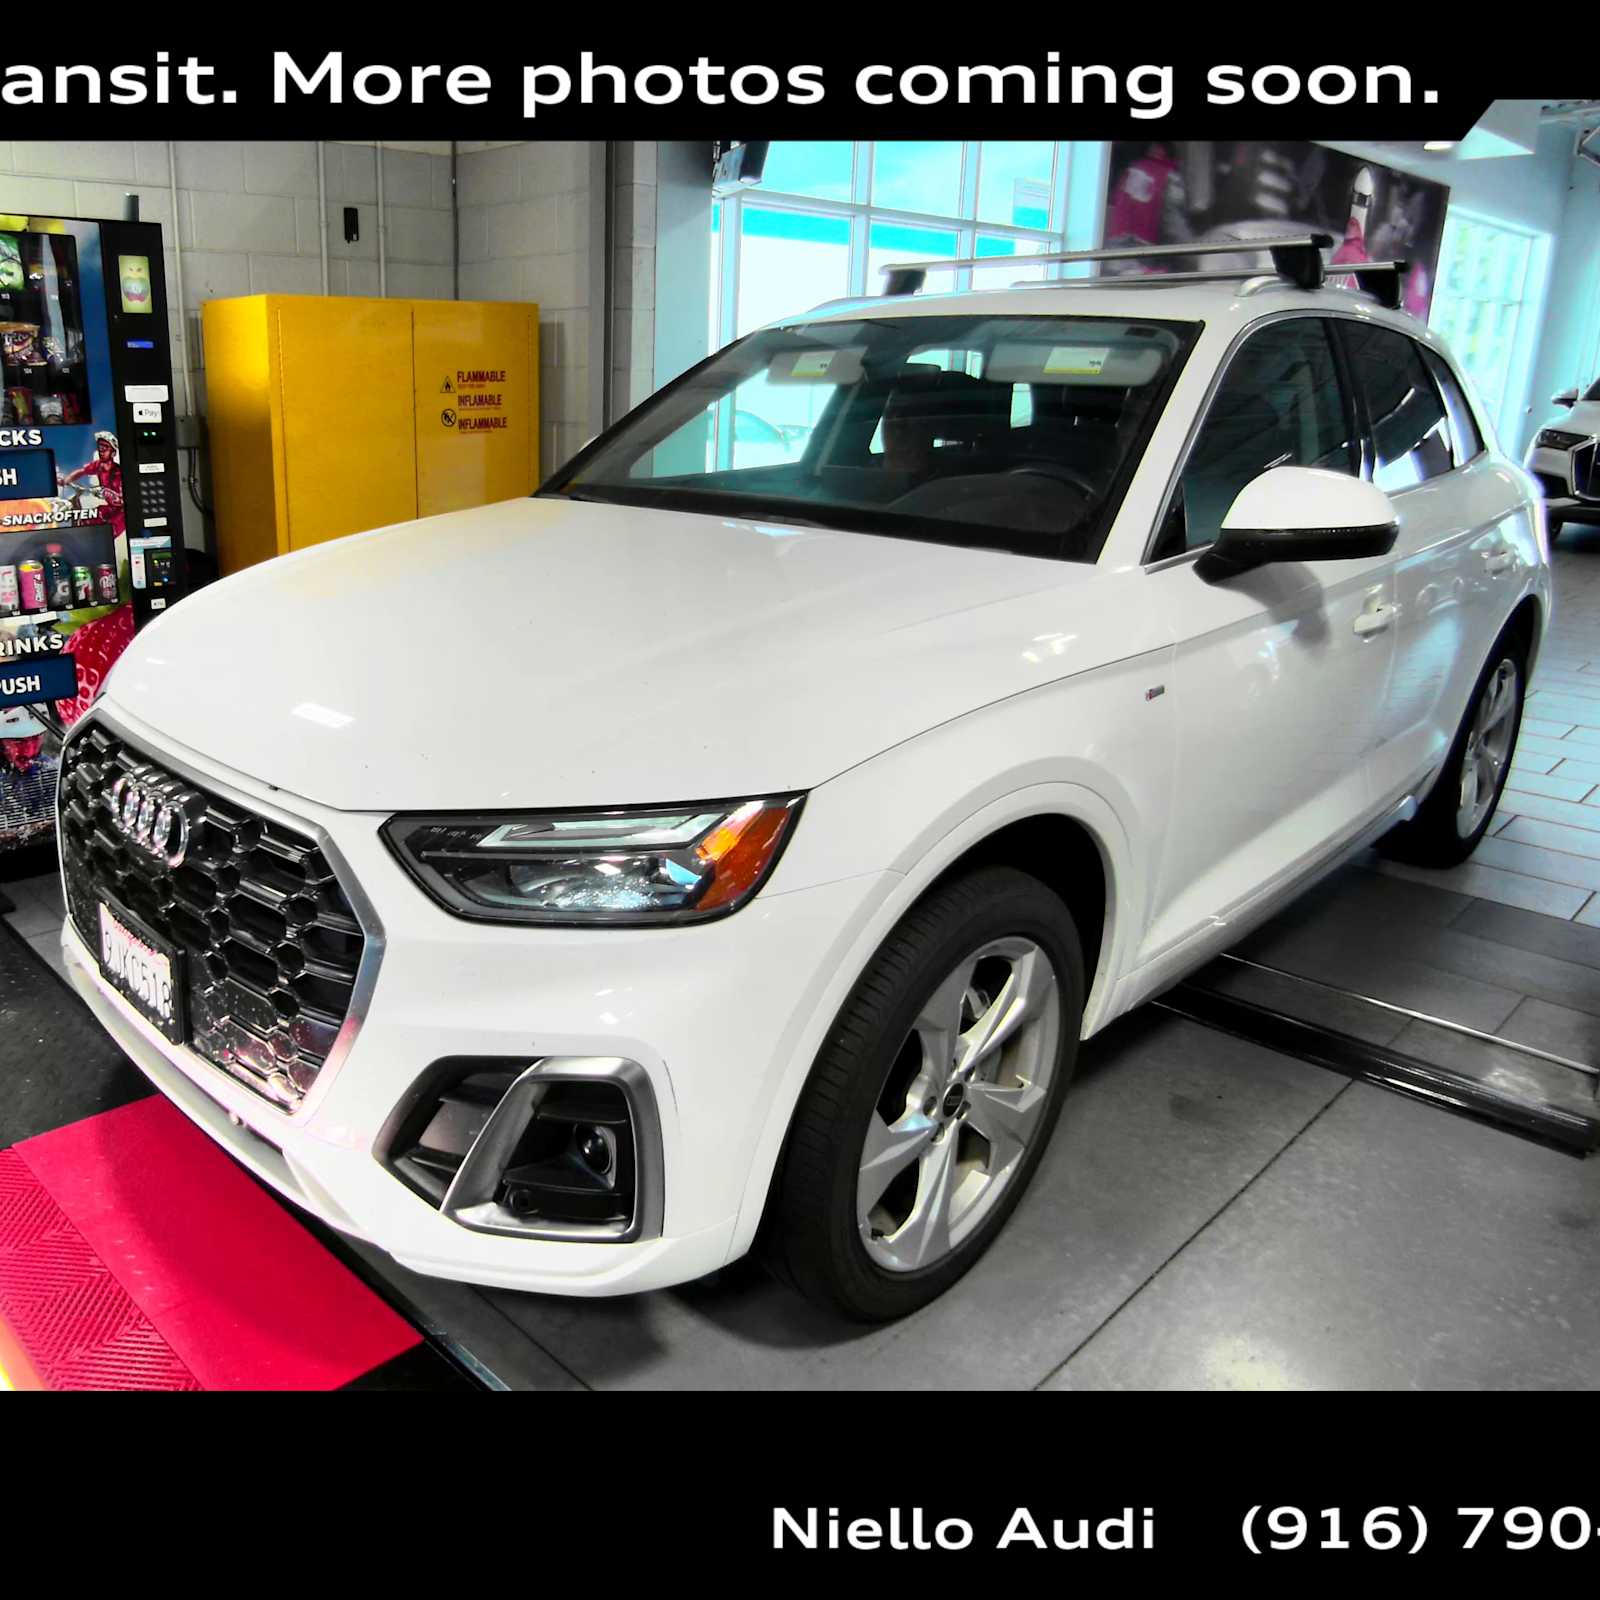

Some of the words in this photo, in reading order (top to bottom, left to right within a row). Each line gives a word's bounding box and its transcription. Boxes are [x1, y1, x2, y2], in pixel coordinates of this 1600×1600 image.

[457, 370, 506, 383] FLAMMABLE
[458, 394, 502, 407] INFLAMABLE
[458, 417, 508, 430] INFLAMMABLE
[0, 675, 41, 695] USH
